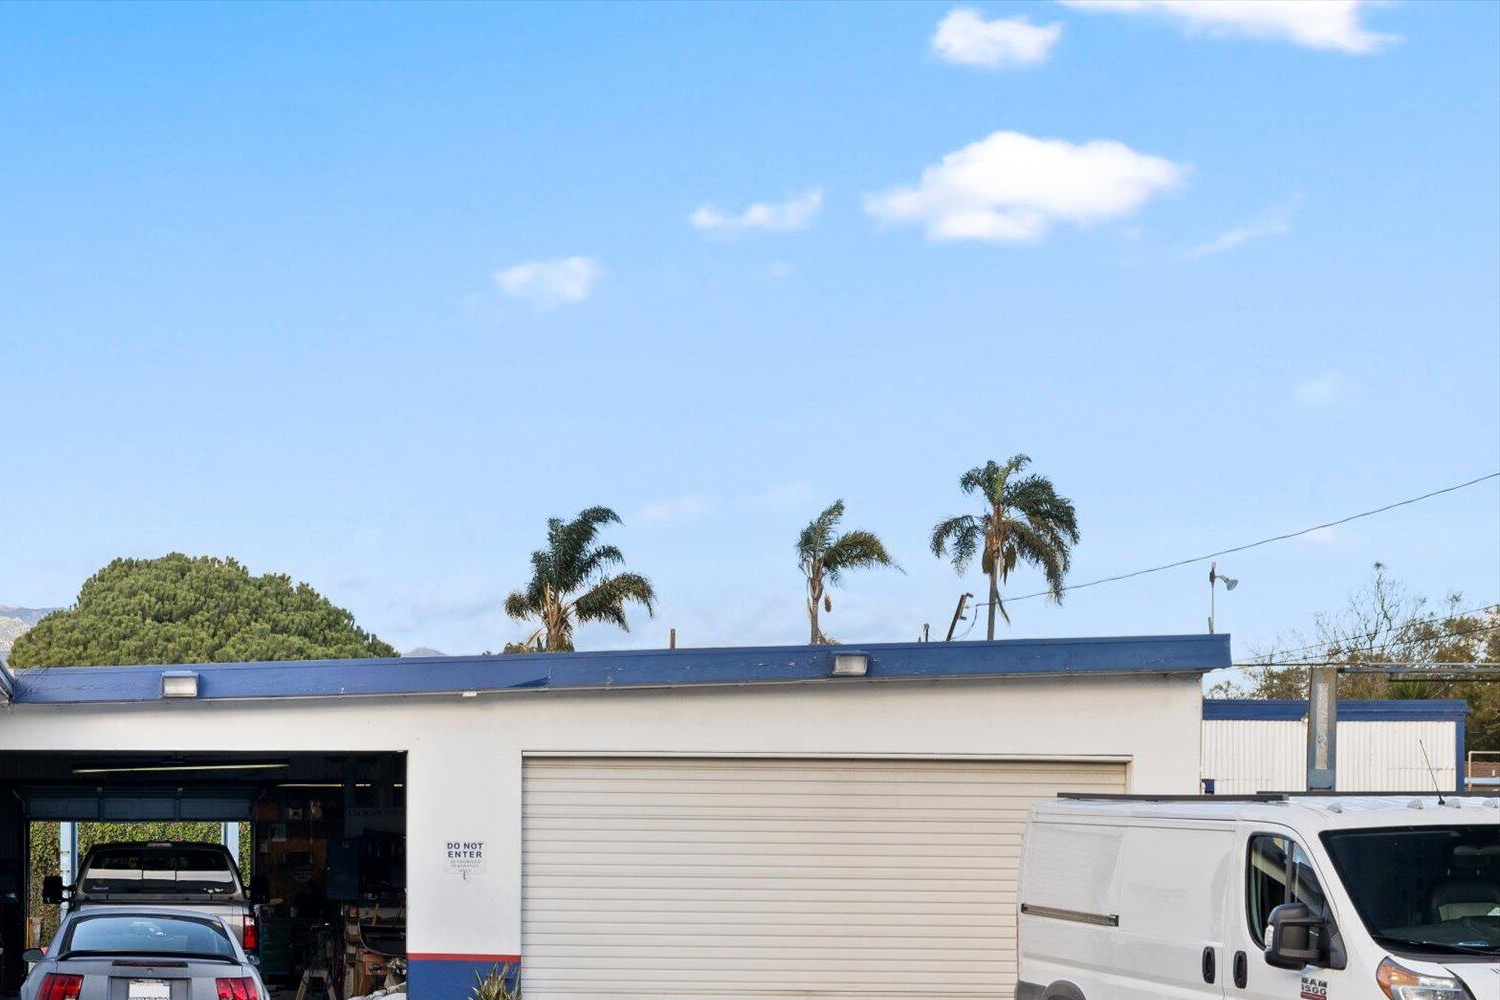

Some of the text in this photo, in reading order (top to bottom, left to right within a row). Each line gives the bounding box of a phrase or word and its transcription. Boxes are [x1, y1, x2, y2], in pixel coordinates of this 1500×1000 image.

[447, 842, 484, 850] DO NOT
[447, 850, 482, 858] ENTER
[1301, 977, 1328, 988] RAM
